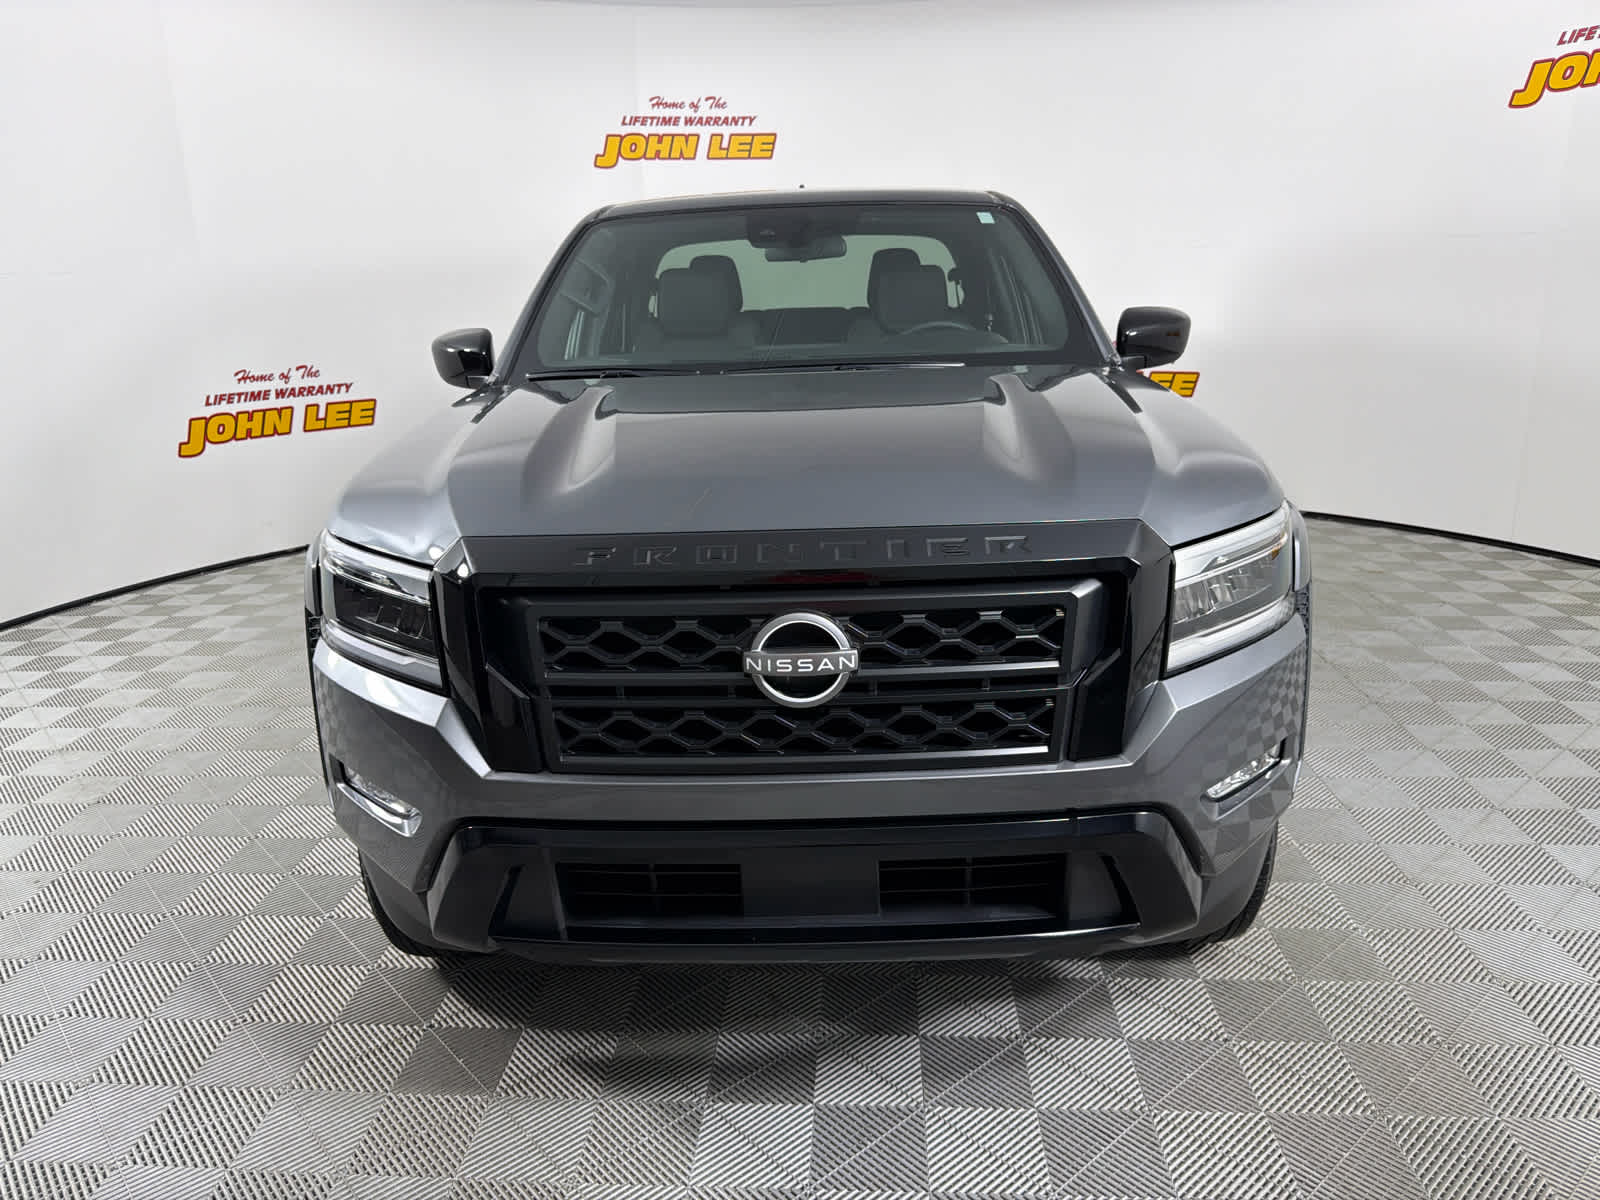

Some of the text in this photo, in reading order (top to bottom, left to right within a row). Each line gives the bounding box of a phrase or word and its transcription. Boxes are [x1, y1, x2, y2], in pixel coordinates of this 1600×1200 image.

[649, 96, 728, 113] Home of The
[621, 115, 757, 127] LIFETIME WARRANTY
[594, 133, 777, 168] JOHN LEE
[233, 365, 320, 384] Home of The
[1148, 371, 1200, 398] EE
[205, 382, 353, 407] LIFETIME WARRANTY
[178, 399, 376, 457] JOHN LEE
[573, 535, 1033, 566] FRONTIER
[745, 655, 855, 672] NISSAN
